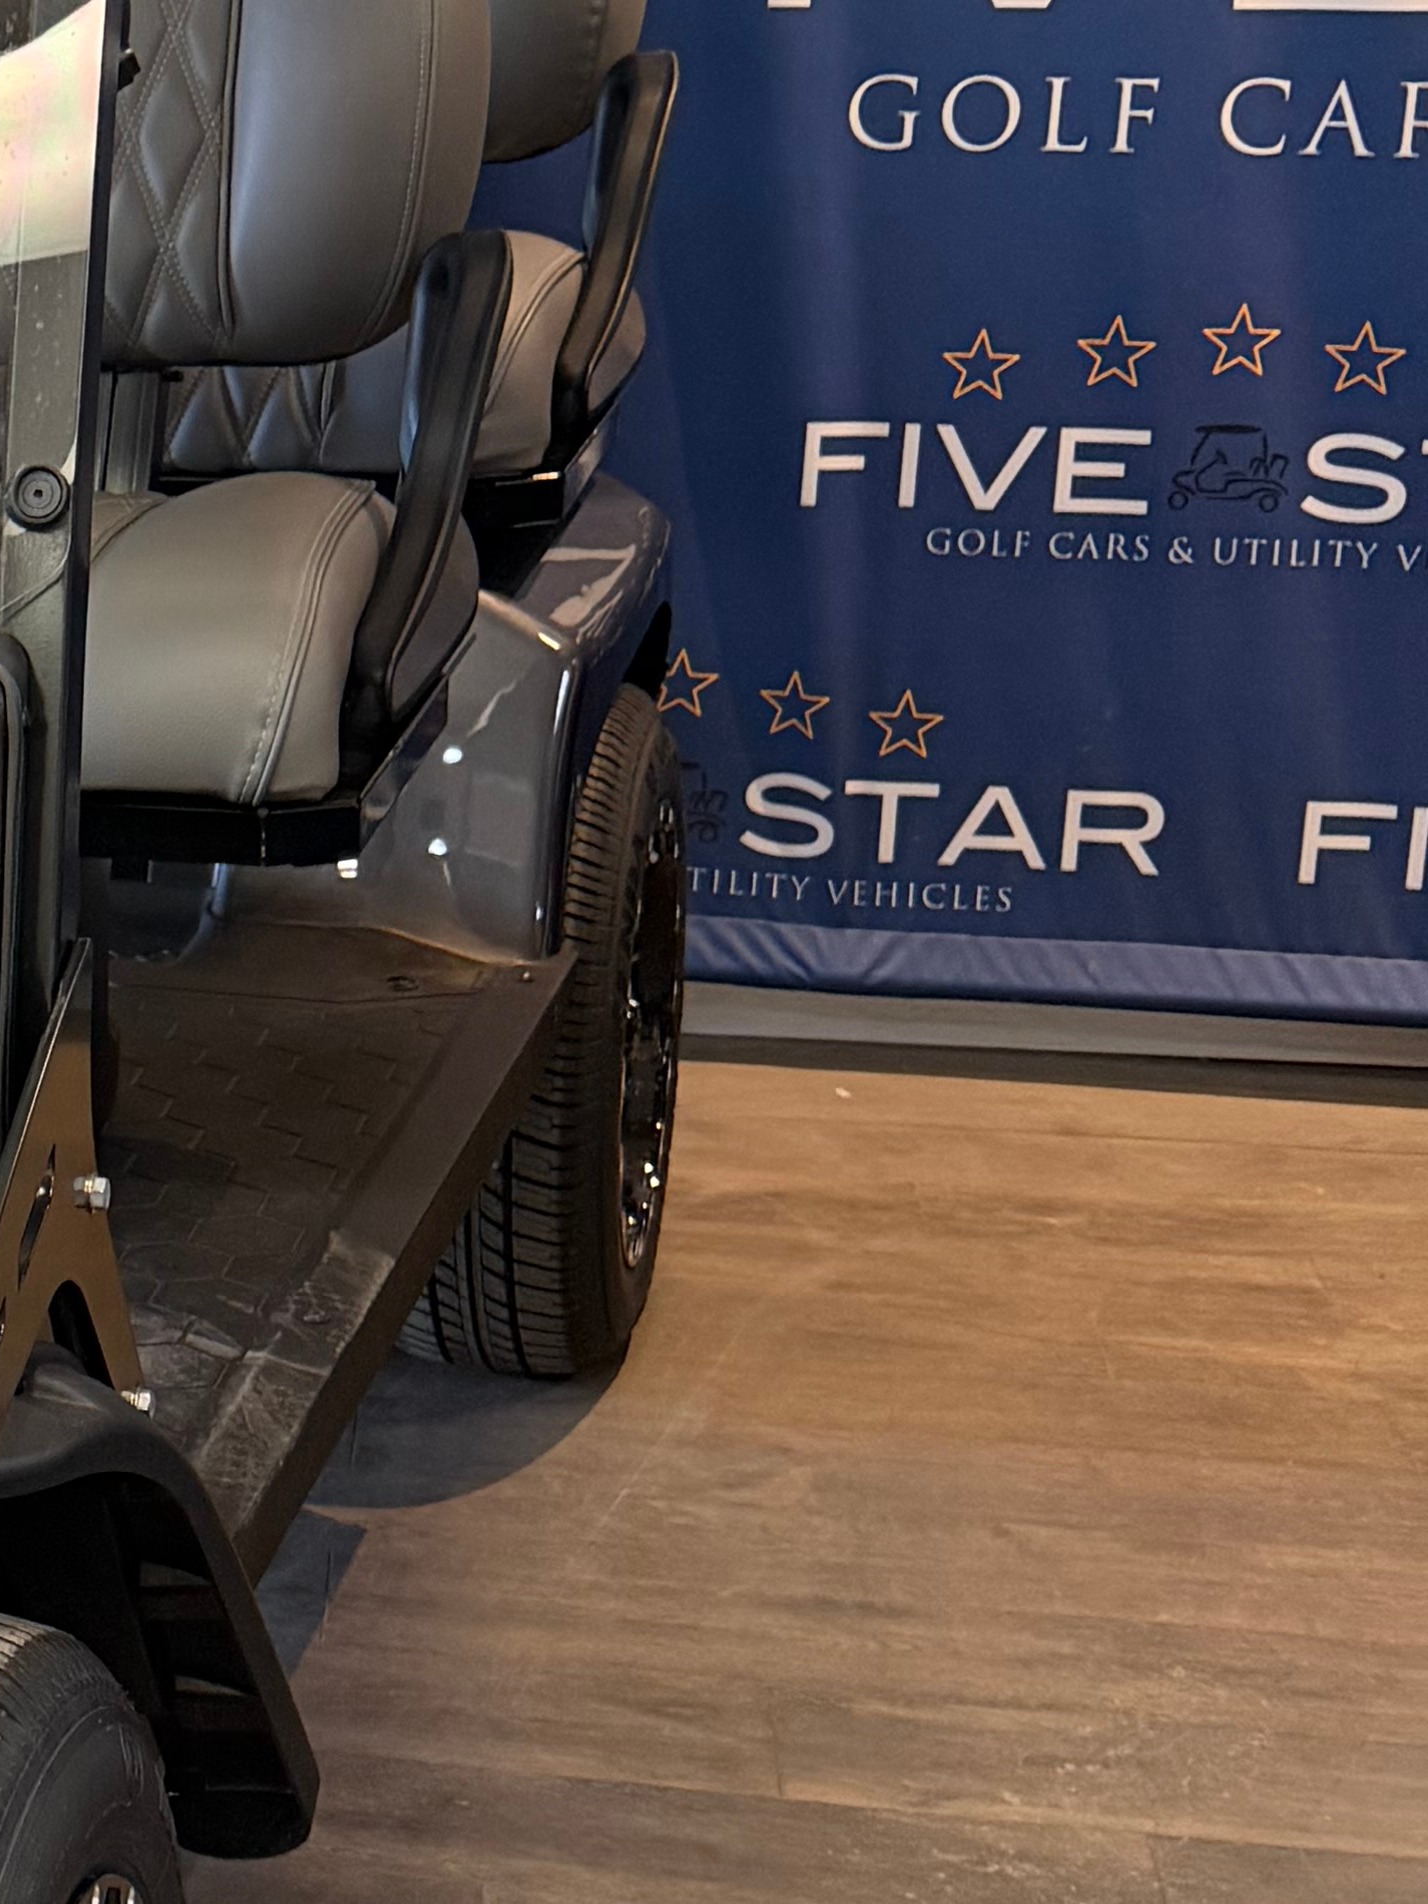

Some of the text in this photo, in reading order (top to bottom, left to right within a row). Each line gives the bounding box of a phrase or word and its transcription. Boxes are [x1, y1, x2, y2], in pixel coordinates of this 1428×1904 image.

[849, 74, 1161, 154] GOLF
[800, 421, 1152, 515] FIVE
[926, 527, 1030, 558] GOLF
[1048, 531, 1150, 563] CARS
[1167, 536, 1194, 565] &
[1214, 537, 1378, 569] UTILITY
[740, 772, 1166, 877] STAR
[686, 866, 1013, 913] TILITY VEHICLES
